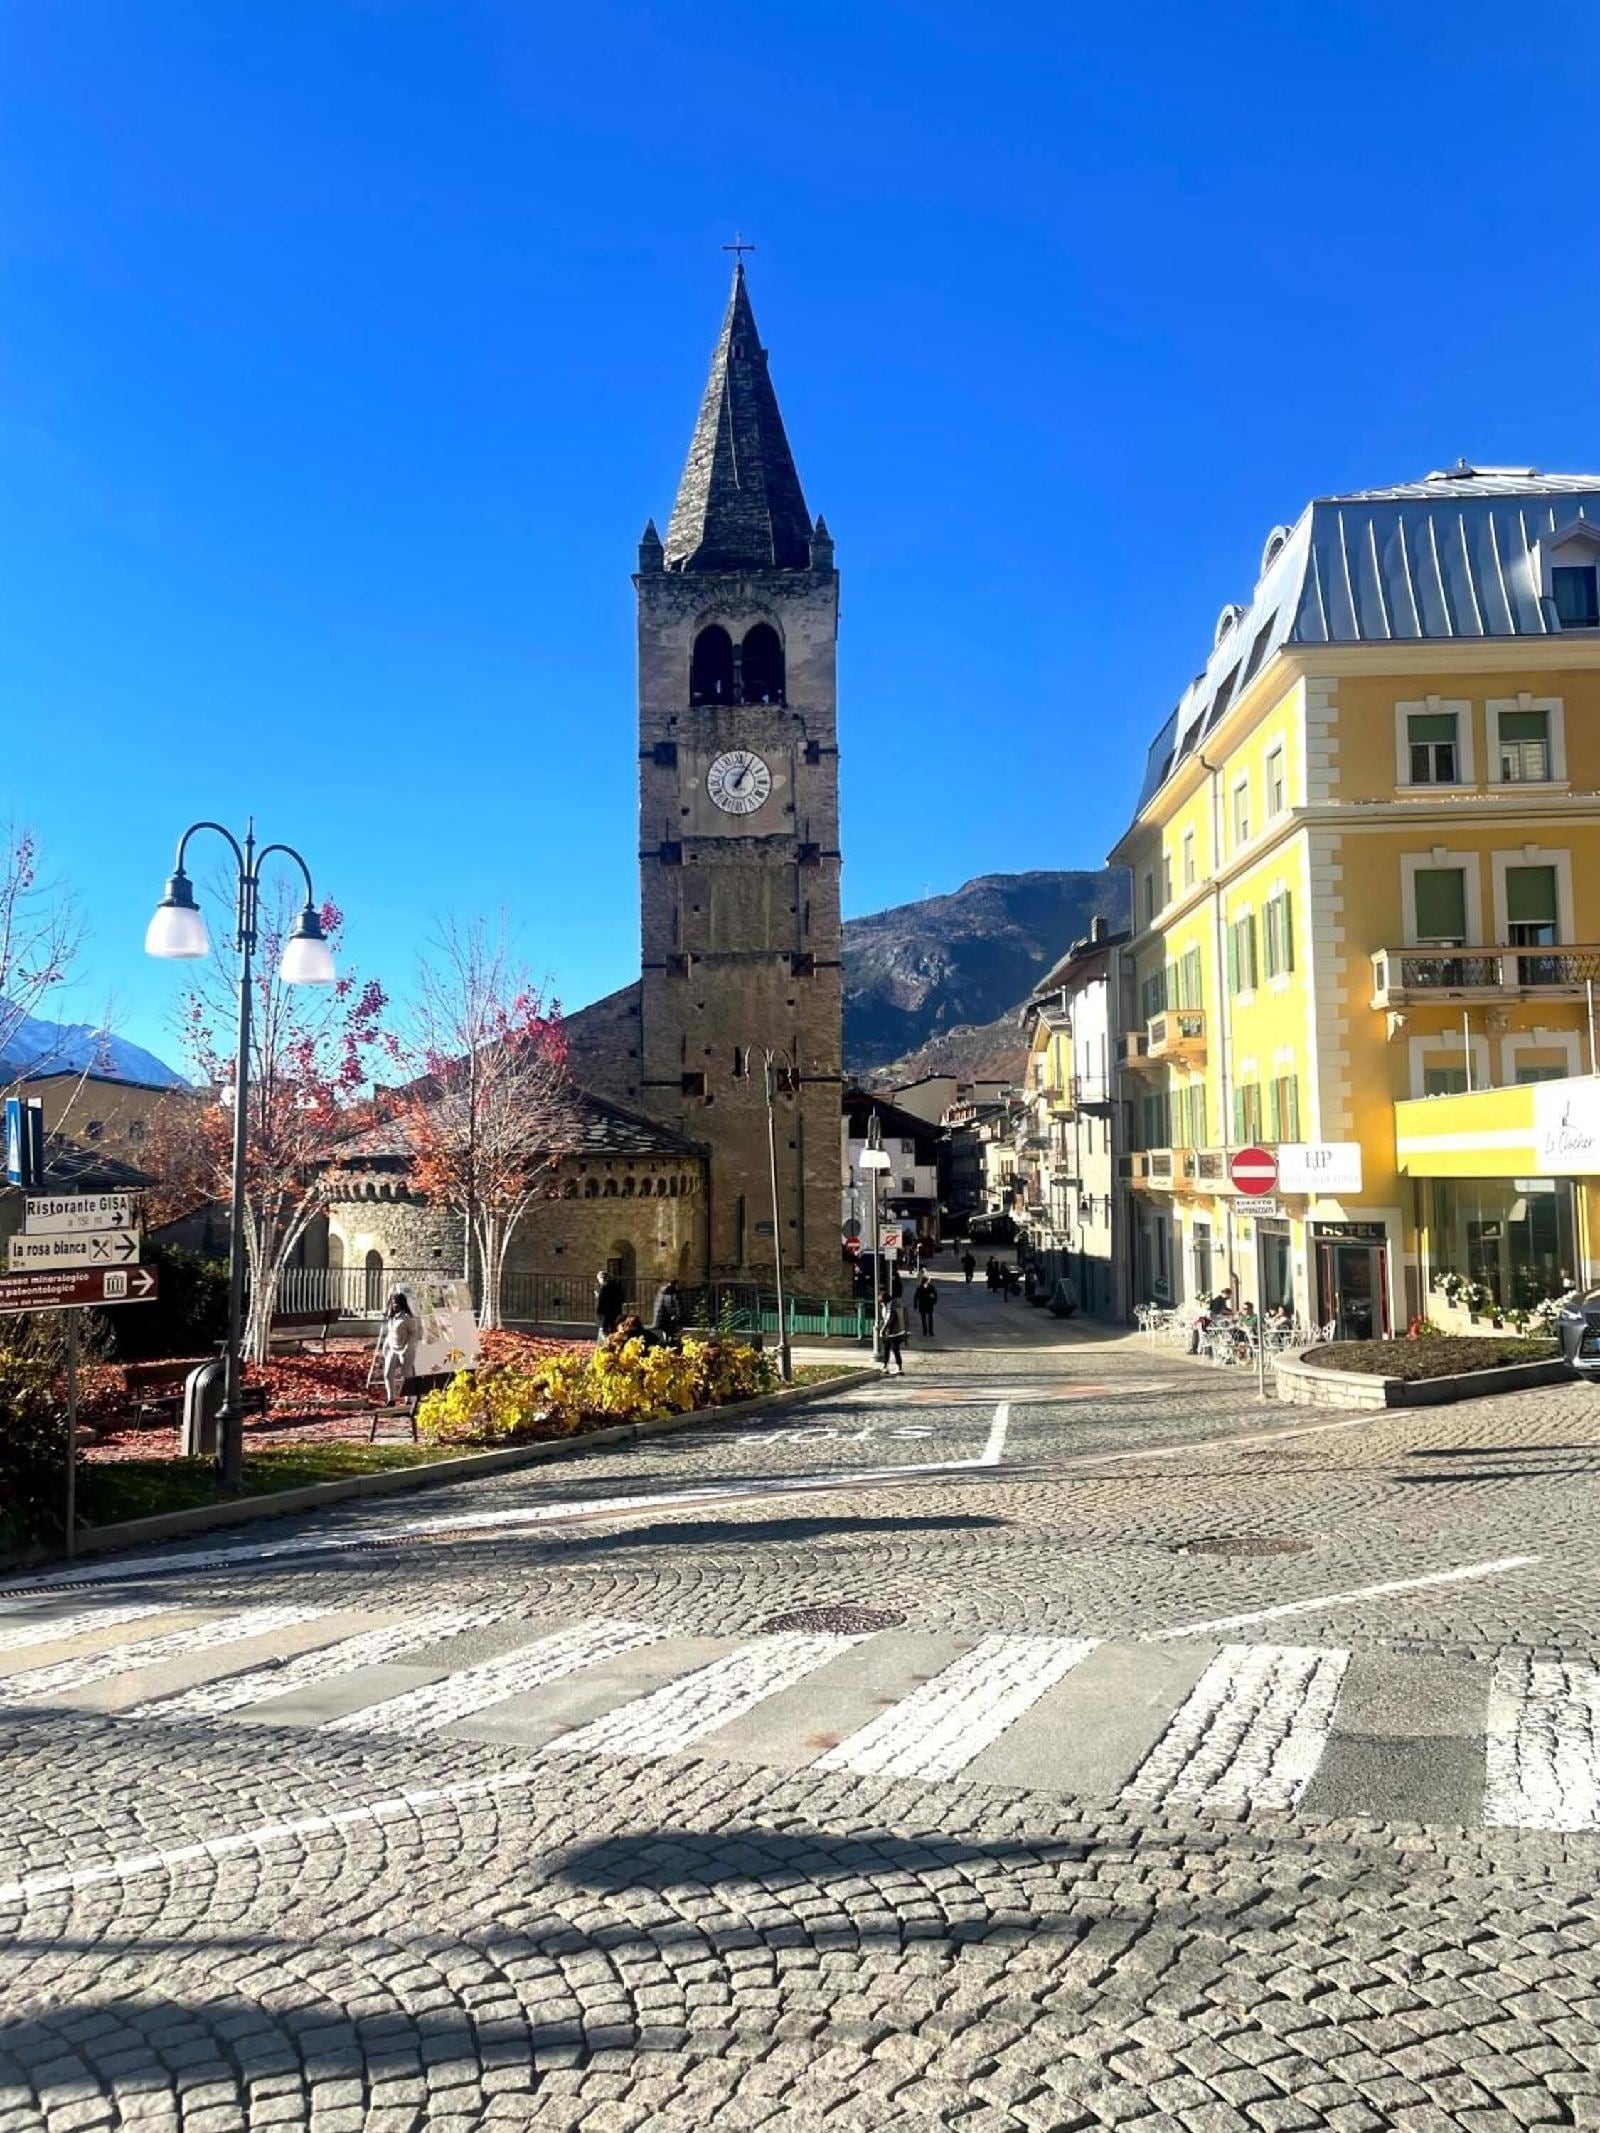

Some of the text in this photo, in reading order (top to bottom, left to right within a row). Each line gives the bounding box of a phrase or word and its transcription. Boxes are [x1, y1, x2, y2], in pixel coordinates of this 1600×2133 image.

[27, 1196, 127, 1216] Ristorante GISA
[1321, 1223, 1376, 1237] HOTEL
[13, 1241, 87, 1257] la rosa bianca
[30, 1272, 90, 1285] mineralogico
[6, 1284, 76, 1298] paleontologico
